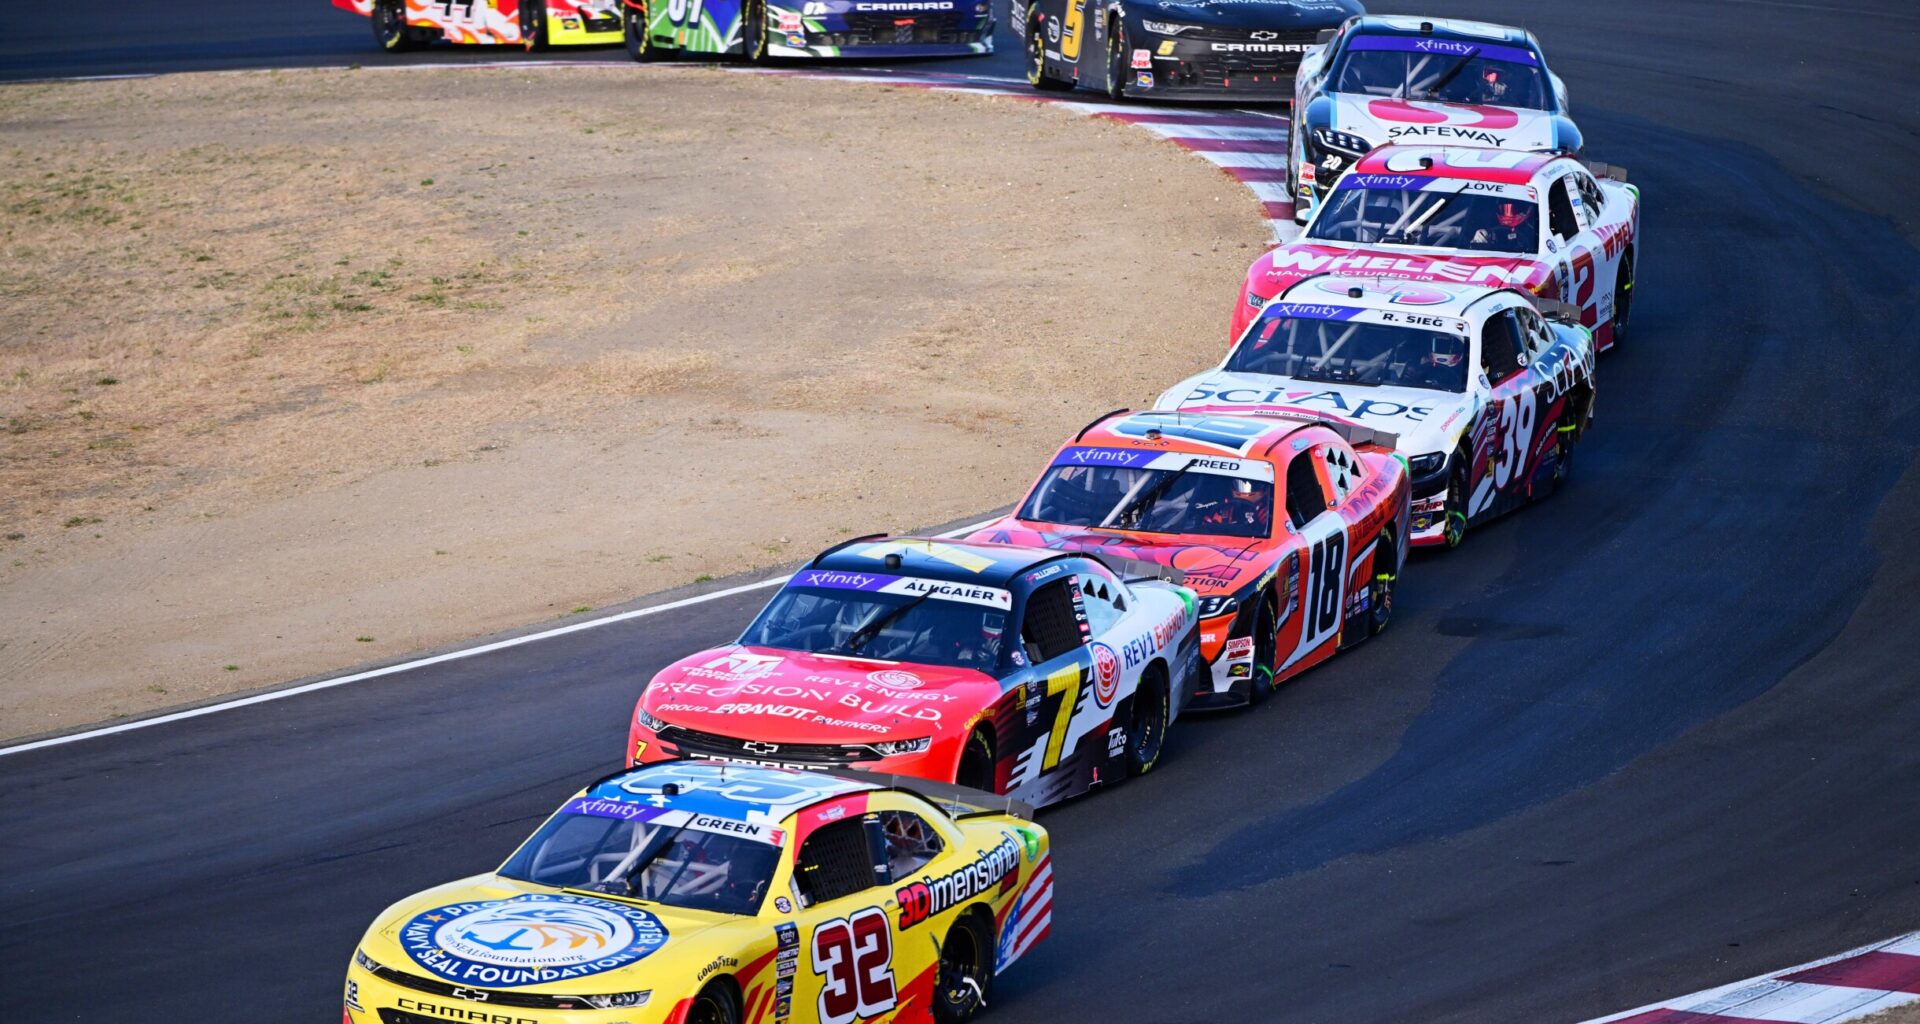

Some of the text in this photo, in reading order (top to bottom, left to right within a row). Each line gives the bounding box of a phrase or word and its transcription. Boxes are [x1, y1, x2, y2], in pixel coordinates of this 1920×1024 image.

[856, 2, 954, 11] CAMARO
[1156, 39, 1177, 55] 5
[1416, 39, 1475, 54] xfinity
[1388, 125, 1507, 147] SAFEWAY
[1321, 154, 1343, 170] 20
[1354, 174, 1417, 187] xfinity
[1466, 182, 1505, 193] LOVE
[1265, 271, 1408, 282] MANACTURED
[1272, 248, 1537, 286] WHELEN
[1570, 245, 1598, 328] 2
[1278, 303, 1444, 327] xfinity R. SIEG
[1184, 381, 1435, 422] SciAps
[1495, 385, 1538, 489] 39
[1072, 449, 1140, 464] xfinity
[806, 571, 876, 588] xfinity
[1306, 530, 1345, 643] 18
[1122, 631, 1156, 671] REV1
[1154, 603, 1185, 651] ENERGY
[1228, 638, 1251, 650] SIMPSON
[648, 681, 943, 722] PRECISION BUILD
[804, 675, 959, 703] REV1 ENERGY
[656, 702, 893, 734] PROUD BRANDT PARTNERS
[1040, 661, 1081, 775] 7
[634, 740, 648, 760] 7
[575, 799, 761, 836] xfinity GREEN
[896, 831, 1022, 931] 3Dimensional
[442, 892, 661, 947] PROUD SUPPORTER
[406, 922, 634, 985] NAVY SEAL FOUNDATION
[813, 907, 897, 1022] 32
[697, 955, 739, 982] GOODYEAR
[348, 979, 359, 1003] 32
[398, 998, 540, 1024] CAMARO
